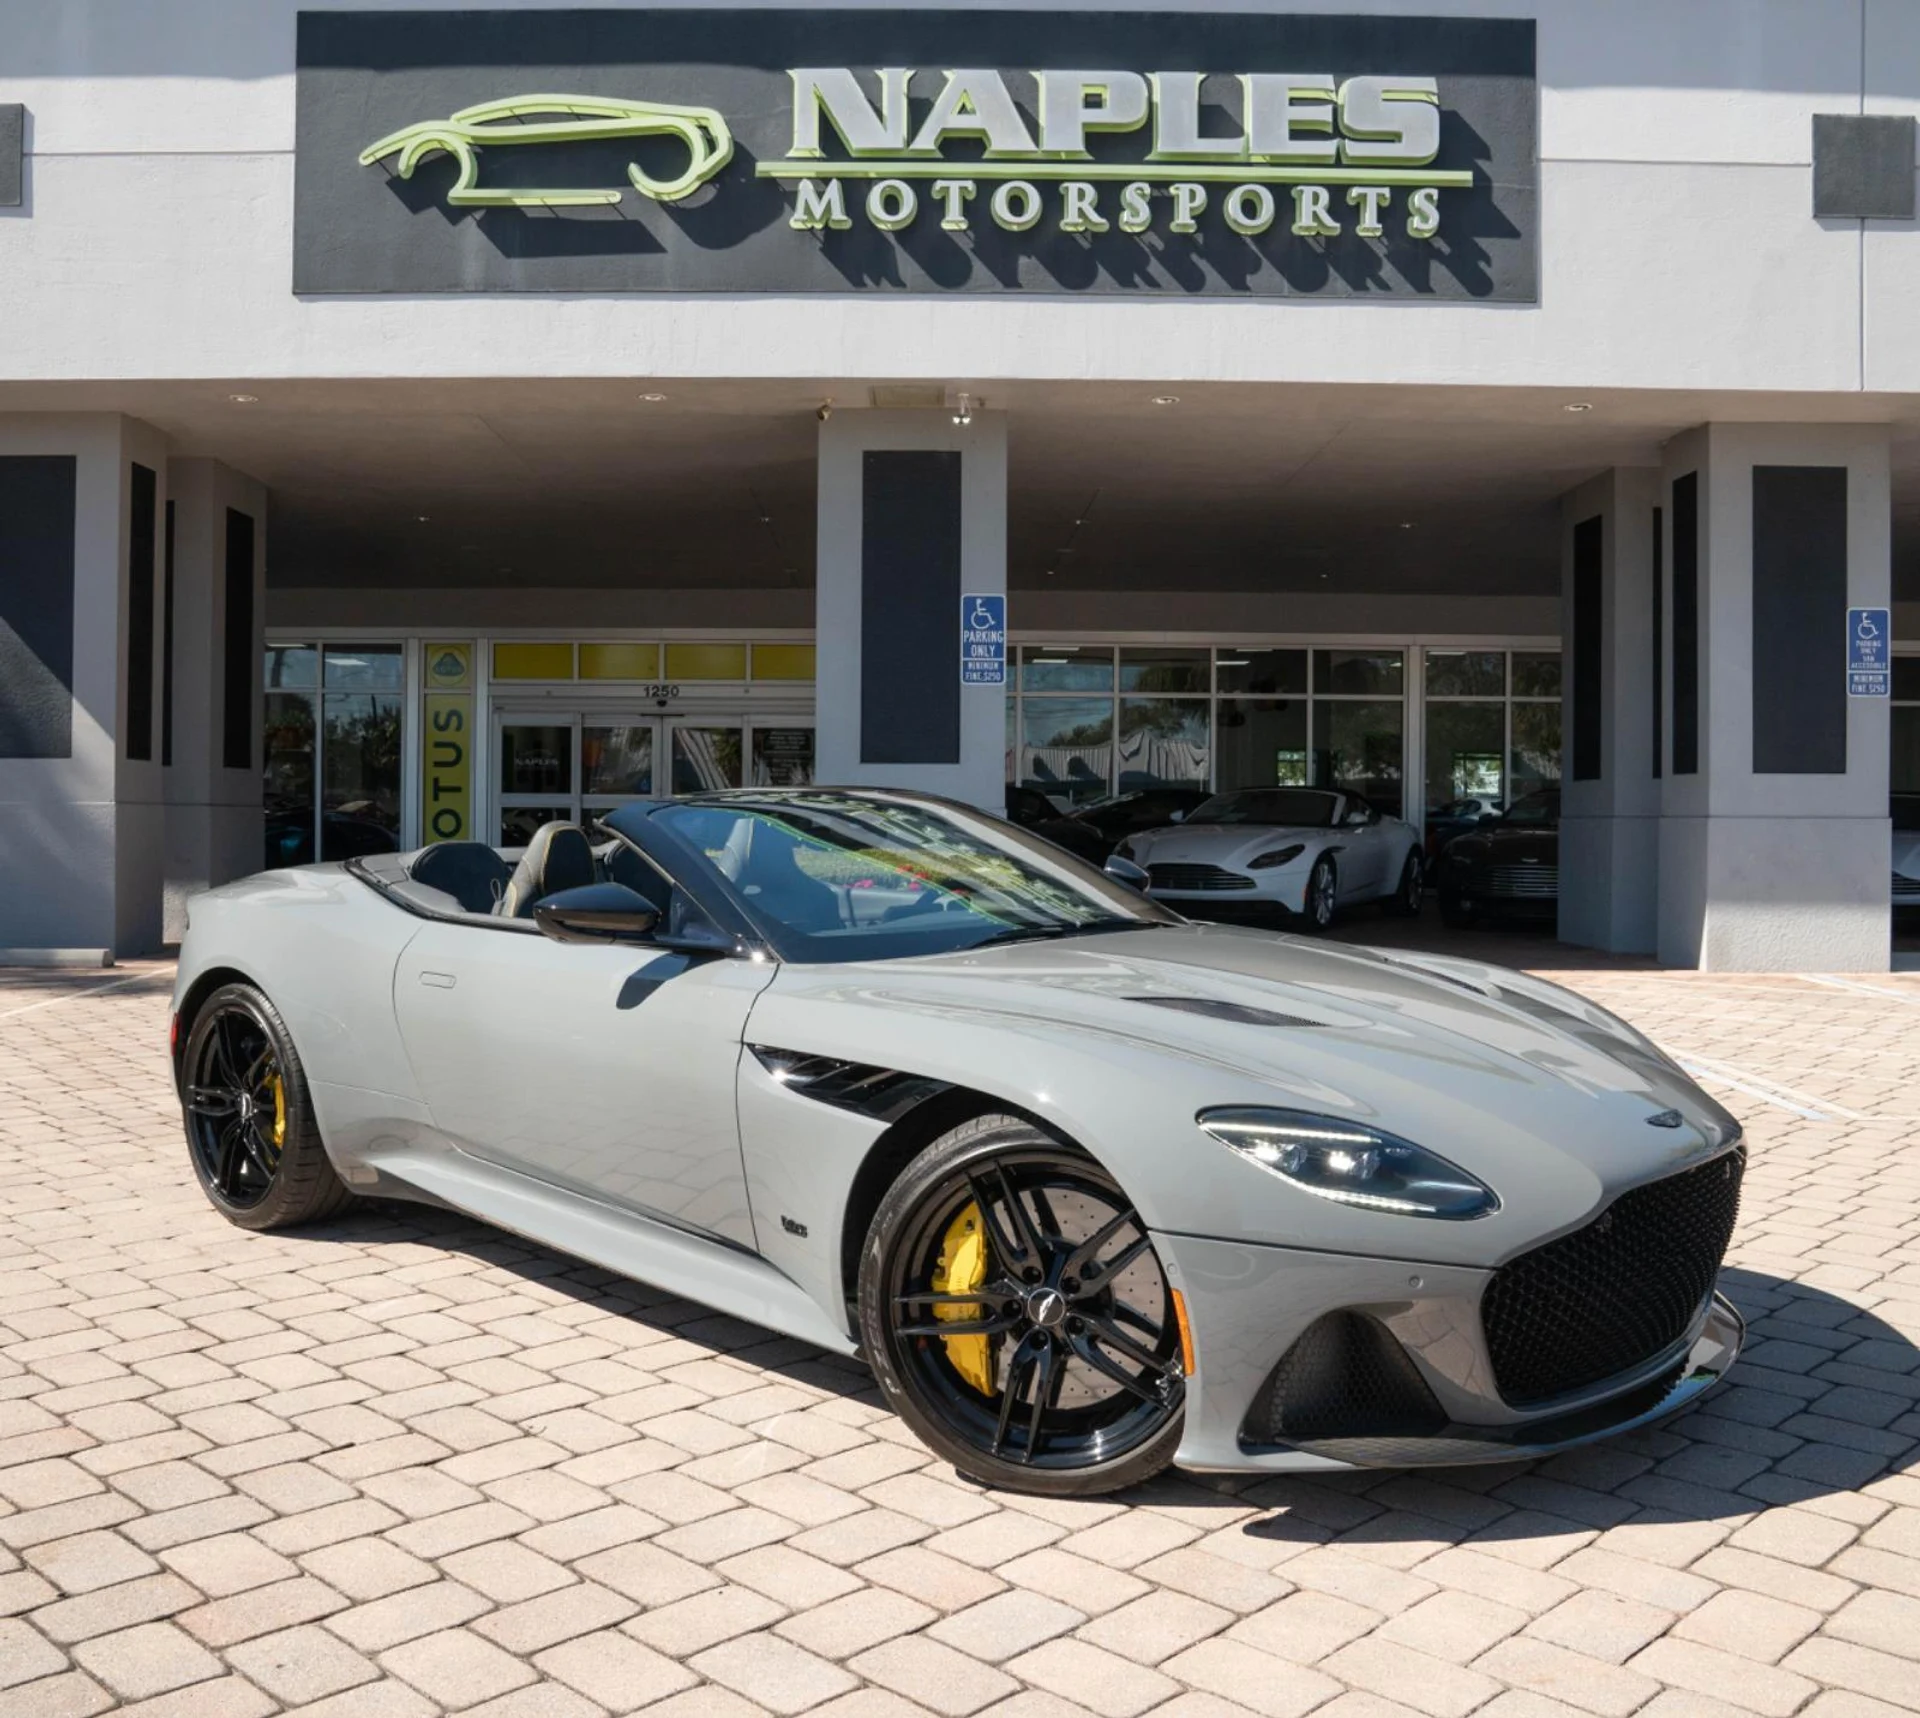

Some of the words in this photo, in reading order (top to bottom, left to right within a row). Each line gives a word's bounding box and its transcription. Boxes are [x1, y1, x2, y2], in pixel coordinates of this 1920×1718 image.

[785, 67, 1440, 165] NAPLES
[789, 178, 1440, 238] MOTORSPORTS
[963, 630, 1004, 643] PARKING
[970, 644, 996, 657] ONLY
[643, 685, 679, 698] 1250
[432, 708, 464, 839] OTUS
